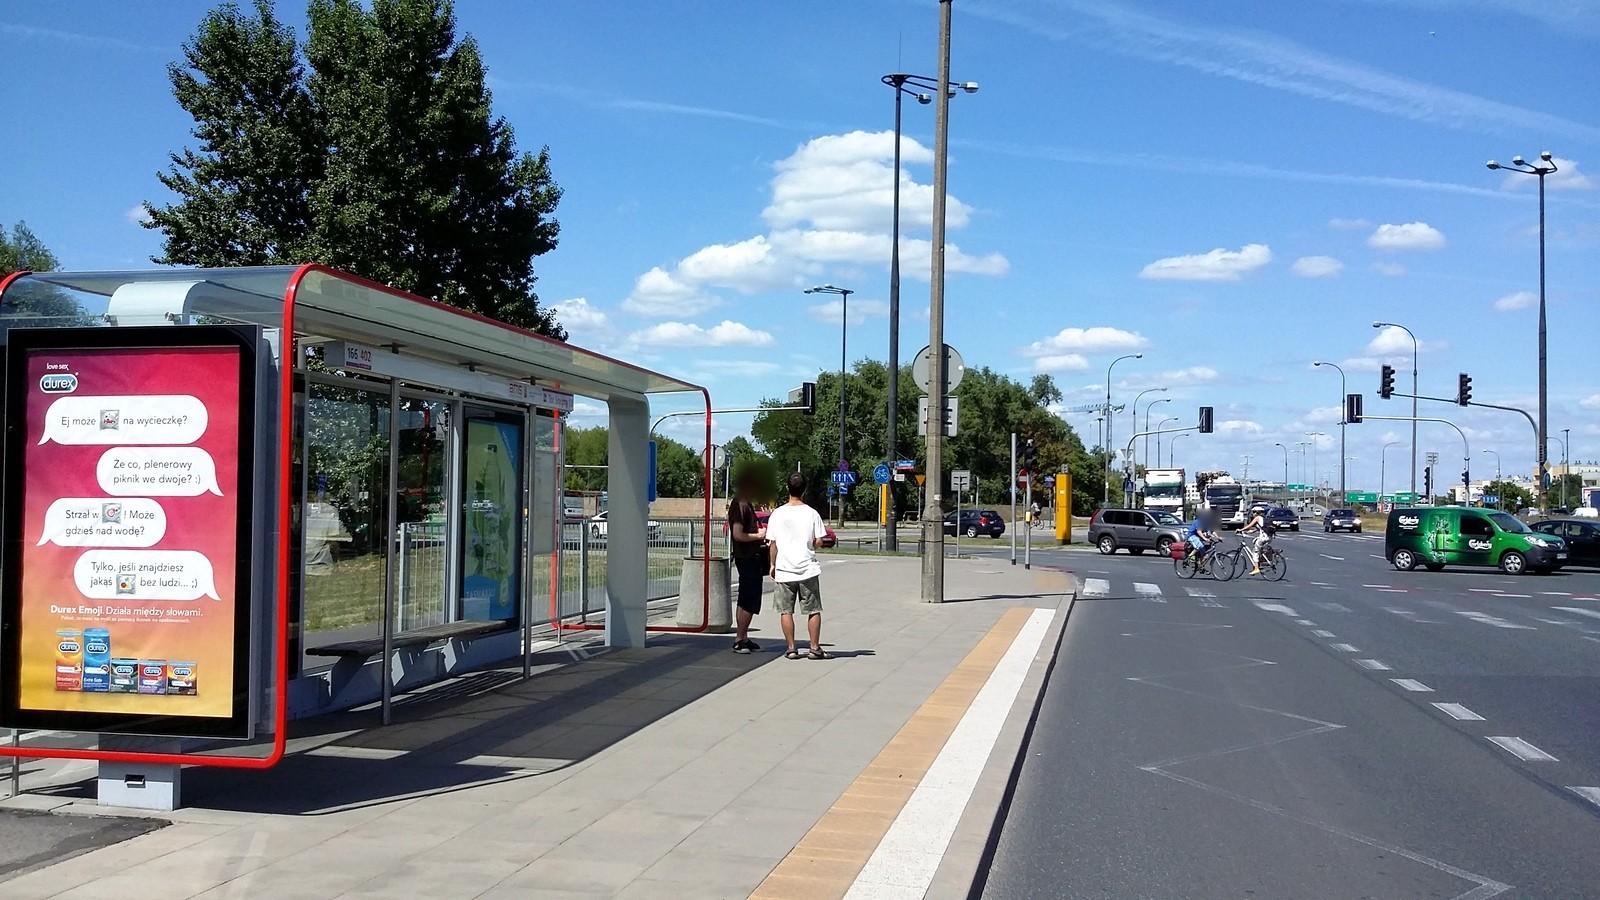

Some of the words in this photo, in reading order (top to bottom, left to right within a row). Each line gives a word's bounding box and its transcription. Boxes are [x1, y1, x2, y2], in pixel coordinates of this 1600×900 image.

[43, 377, 74, 389] durex
[61, 417, 70, 428] Ej
[72, 417, 96, 426] może
[136, 415, 188, 427] wycieczkę?
[113, 459, 126, 469] Że
[127, 461, 141, 470] co,
[144, 460, 193, 472] plenerowy
[113, 475, 140, 485] piknik
[142, 476, 156, 484] we
[158, 475, 193, 486] dwoje?
[65, 510, 90, 519] Strzał
[129, 510, 155, 520] Może
[65, 526, 94, 537] gdzieś
[96, 526, 113, 535] nad
[115, 526, 145, 537] wodę?
[91, 561, 117, 572] Tylko,
[118, 562, 136, 574] jeśli
[138, 562, 184, 576] znajdziesz
[90, 577, 113, 588] jakąś
[140, 578, 157, 587] bez
[159, 579, 189, 587] ludzi...
[50, 605, 77, 614] Durex
[106, 606, 131, 615] Działa
[133, 606, 165, 618] między
